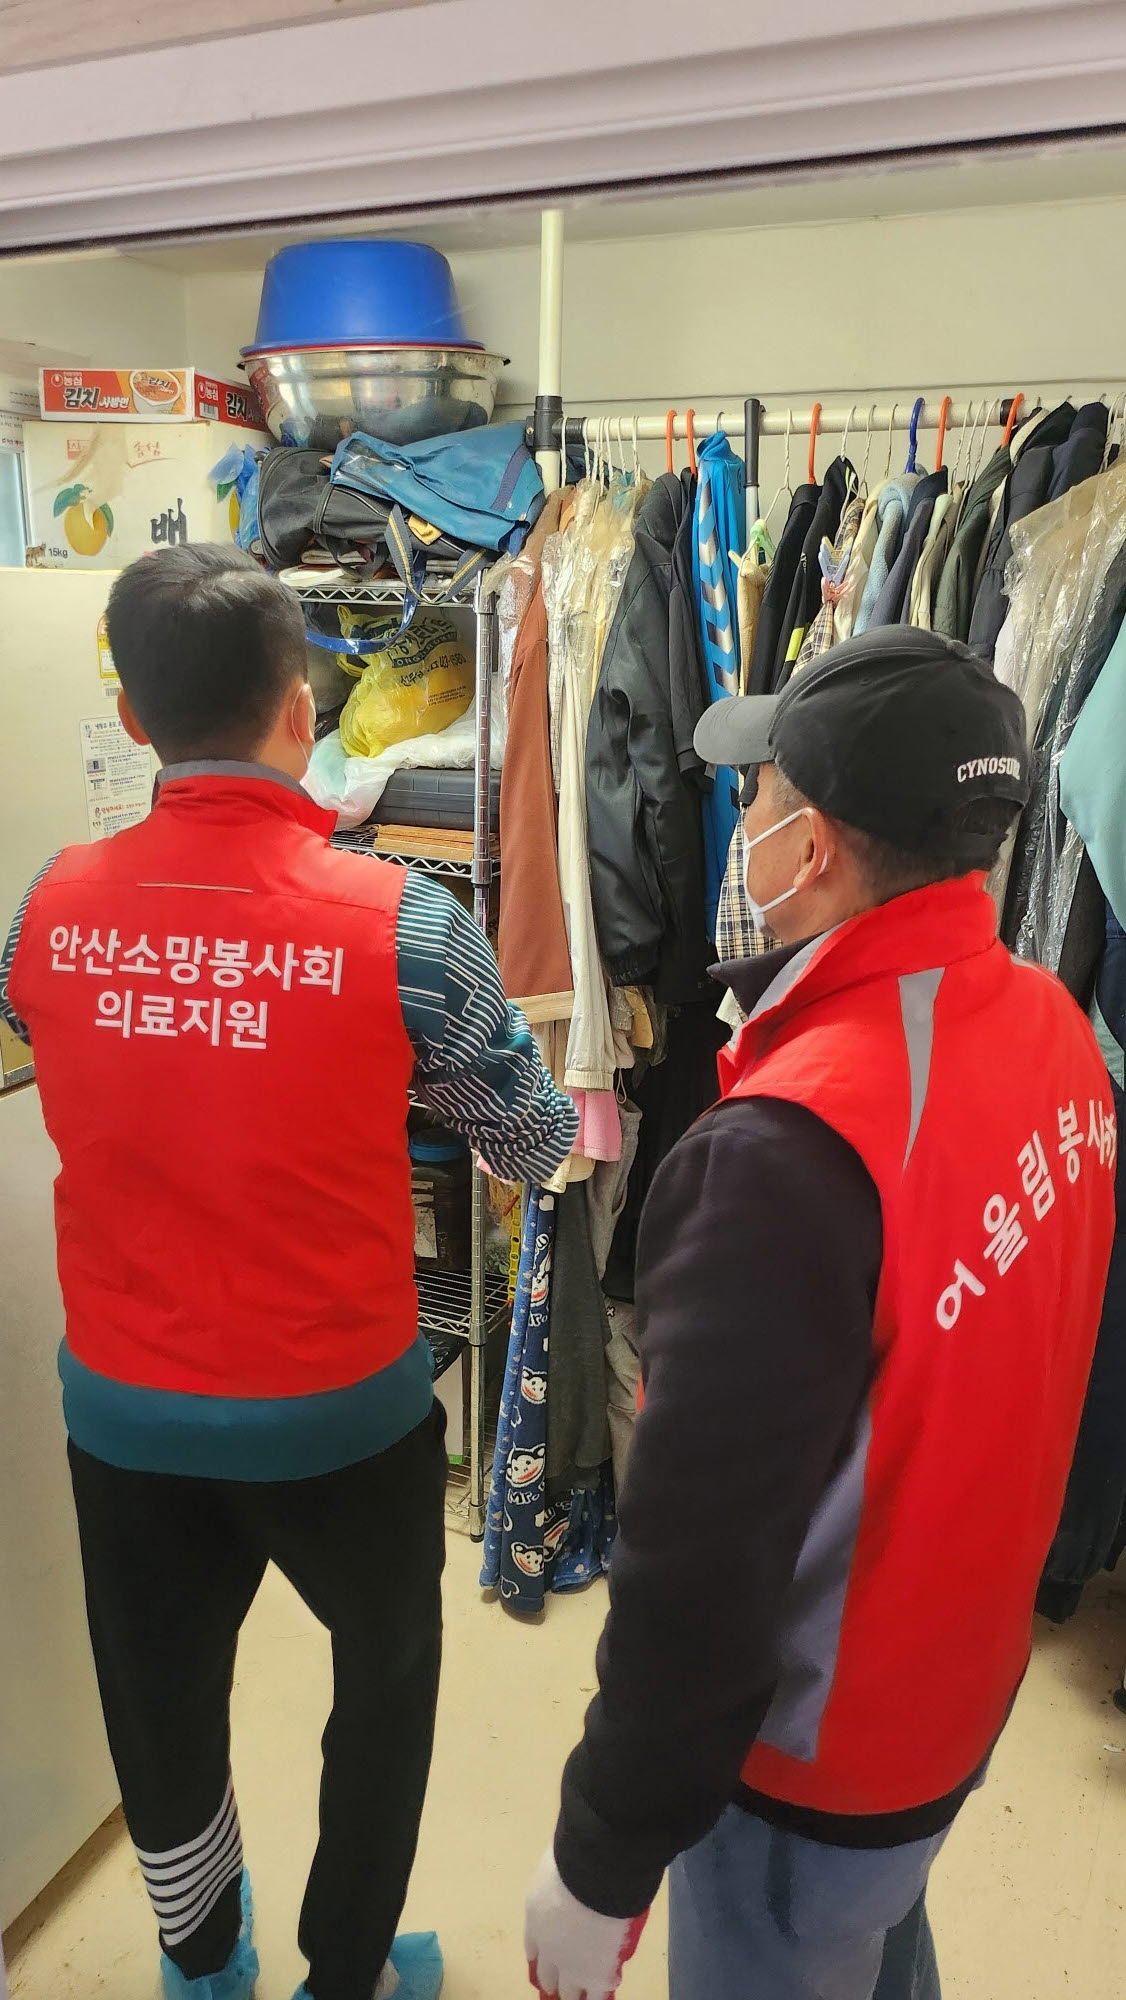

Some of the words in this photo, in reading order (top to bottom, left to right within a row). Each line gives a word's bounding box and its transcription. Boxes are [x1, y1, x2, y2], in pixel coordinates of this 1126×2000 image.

[63, 377, 83, 386] 농심
[205, 386, 219, 401] 농심
[63, 386, 101, 410] 김치
[225, 391, 248, 422] 김치
[150, 498, 188, 547] 배
[48, 548, 68, 558] 15kg
[50, 925, 345, 996] 안산소망봉사회
[95, 989, 269, 1050] 의료지원
